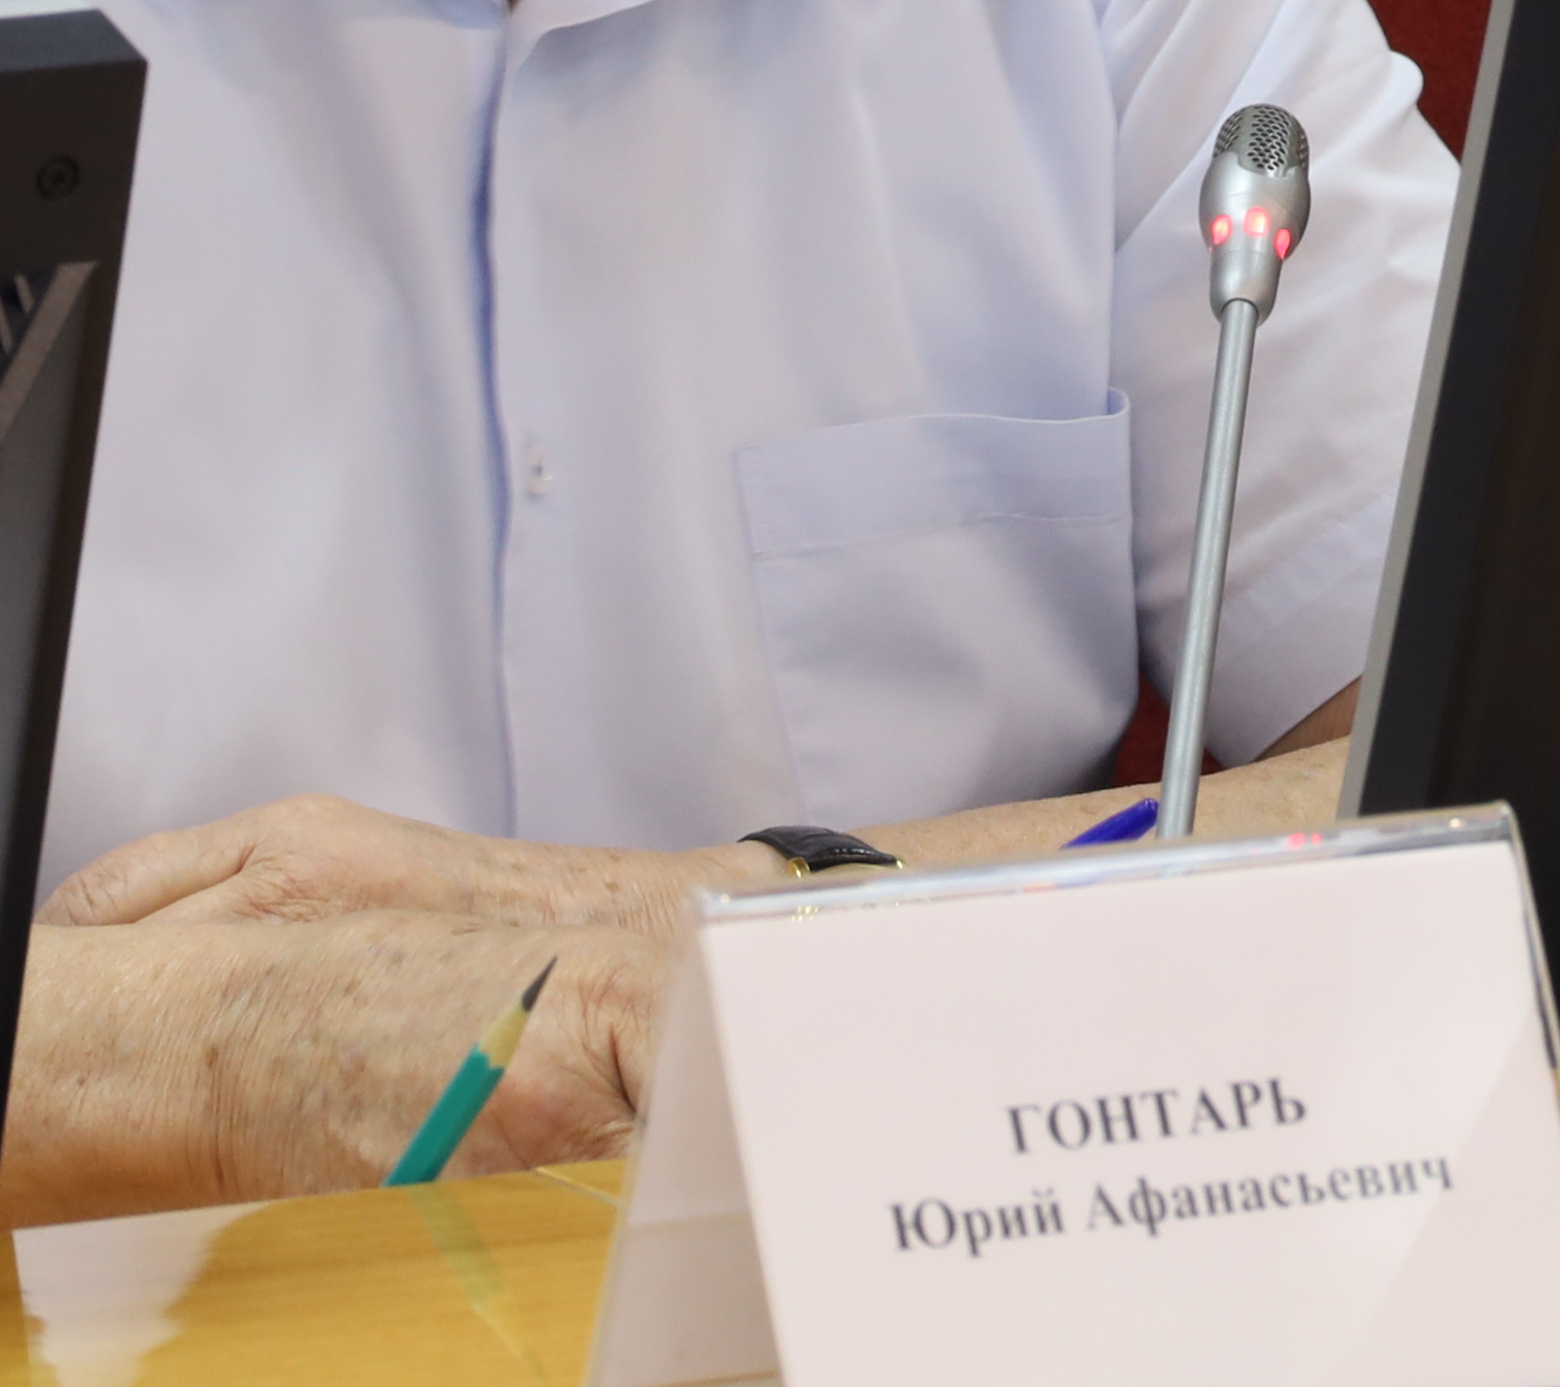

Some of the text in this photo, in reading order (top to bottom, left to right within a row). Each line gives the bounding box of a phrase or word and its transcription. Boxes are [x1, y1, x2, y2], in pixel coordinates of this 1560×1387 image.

[1006, 1076, 1308, 1156] ГОНТАРЬ
[888, 1155, 1455, 1258] Юрий Афанасьевич
